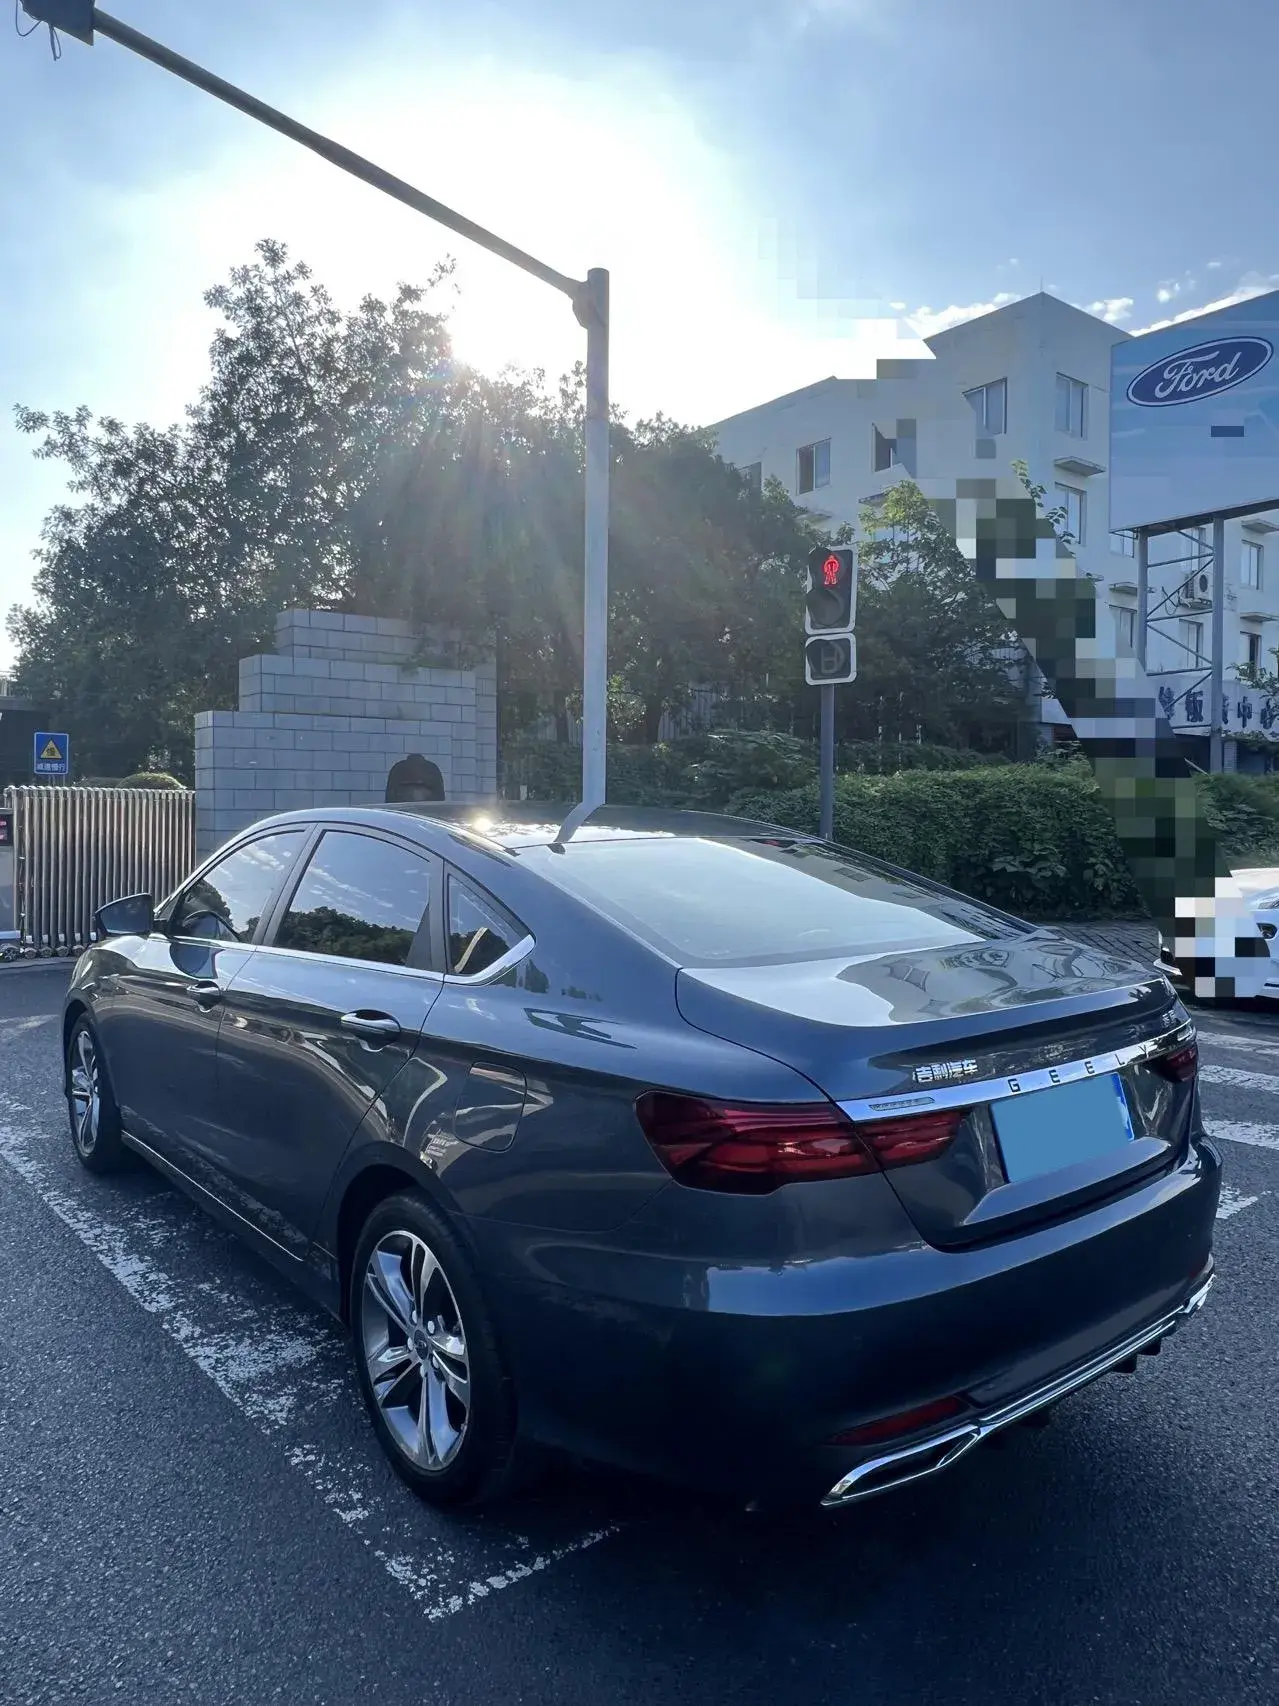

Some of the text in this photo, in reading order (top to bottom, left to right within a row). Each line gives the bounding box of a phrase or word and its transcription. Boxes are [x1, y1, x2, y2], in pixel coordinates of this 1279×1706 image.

[1154, 350, 1242, 399] Ford
[912, 1059, 978, 1083] 吉利汽车
[1007, 1044, 1150, 1093] GEELY
